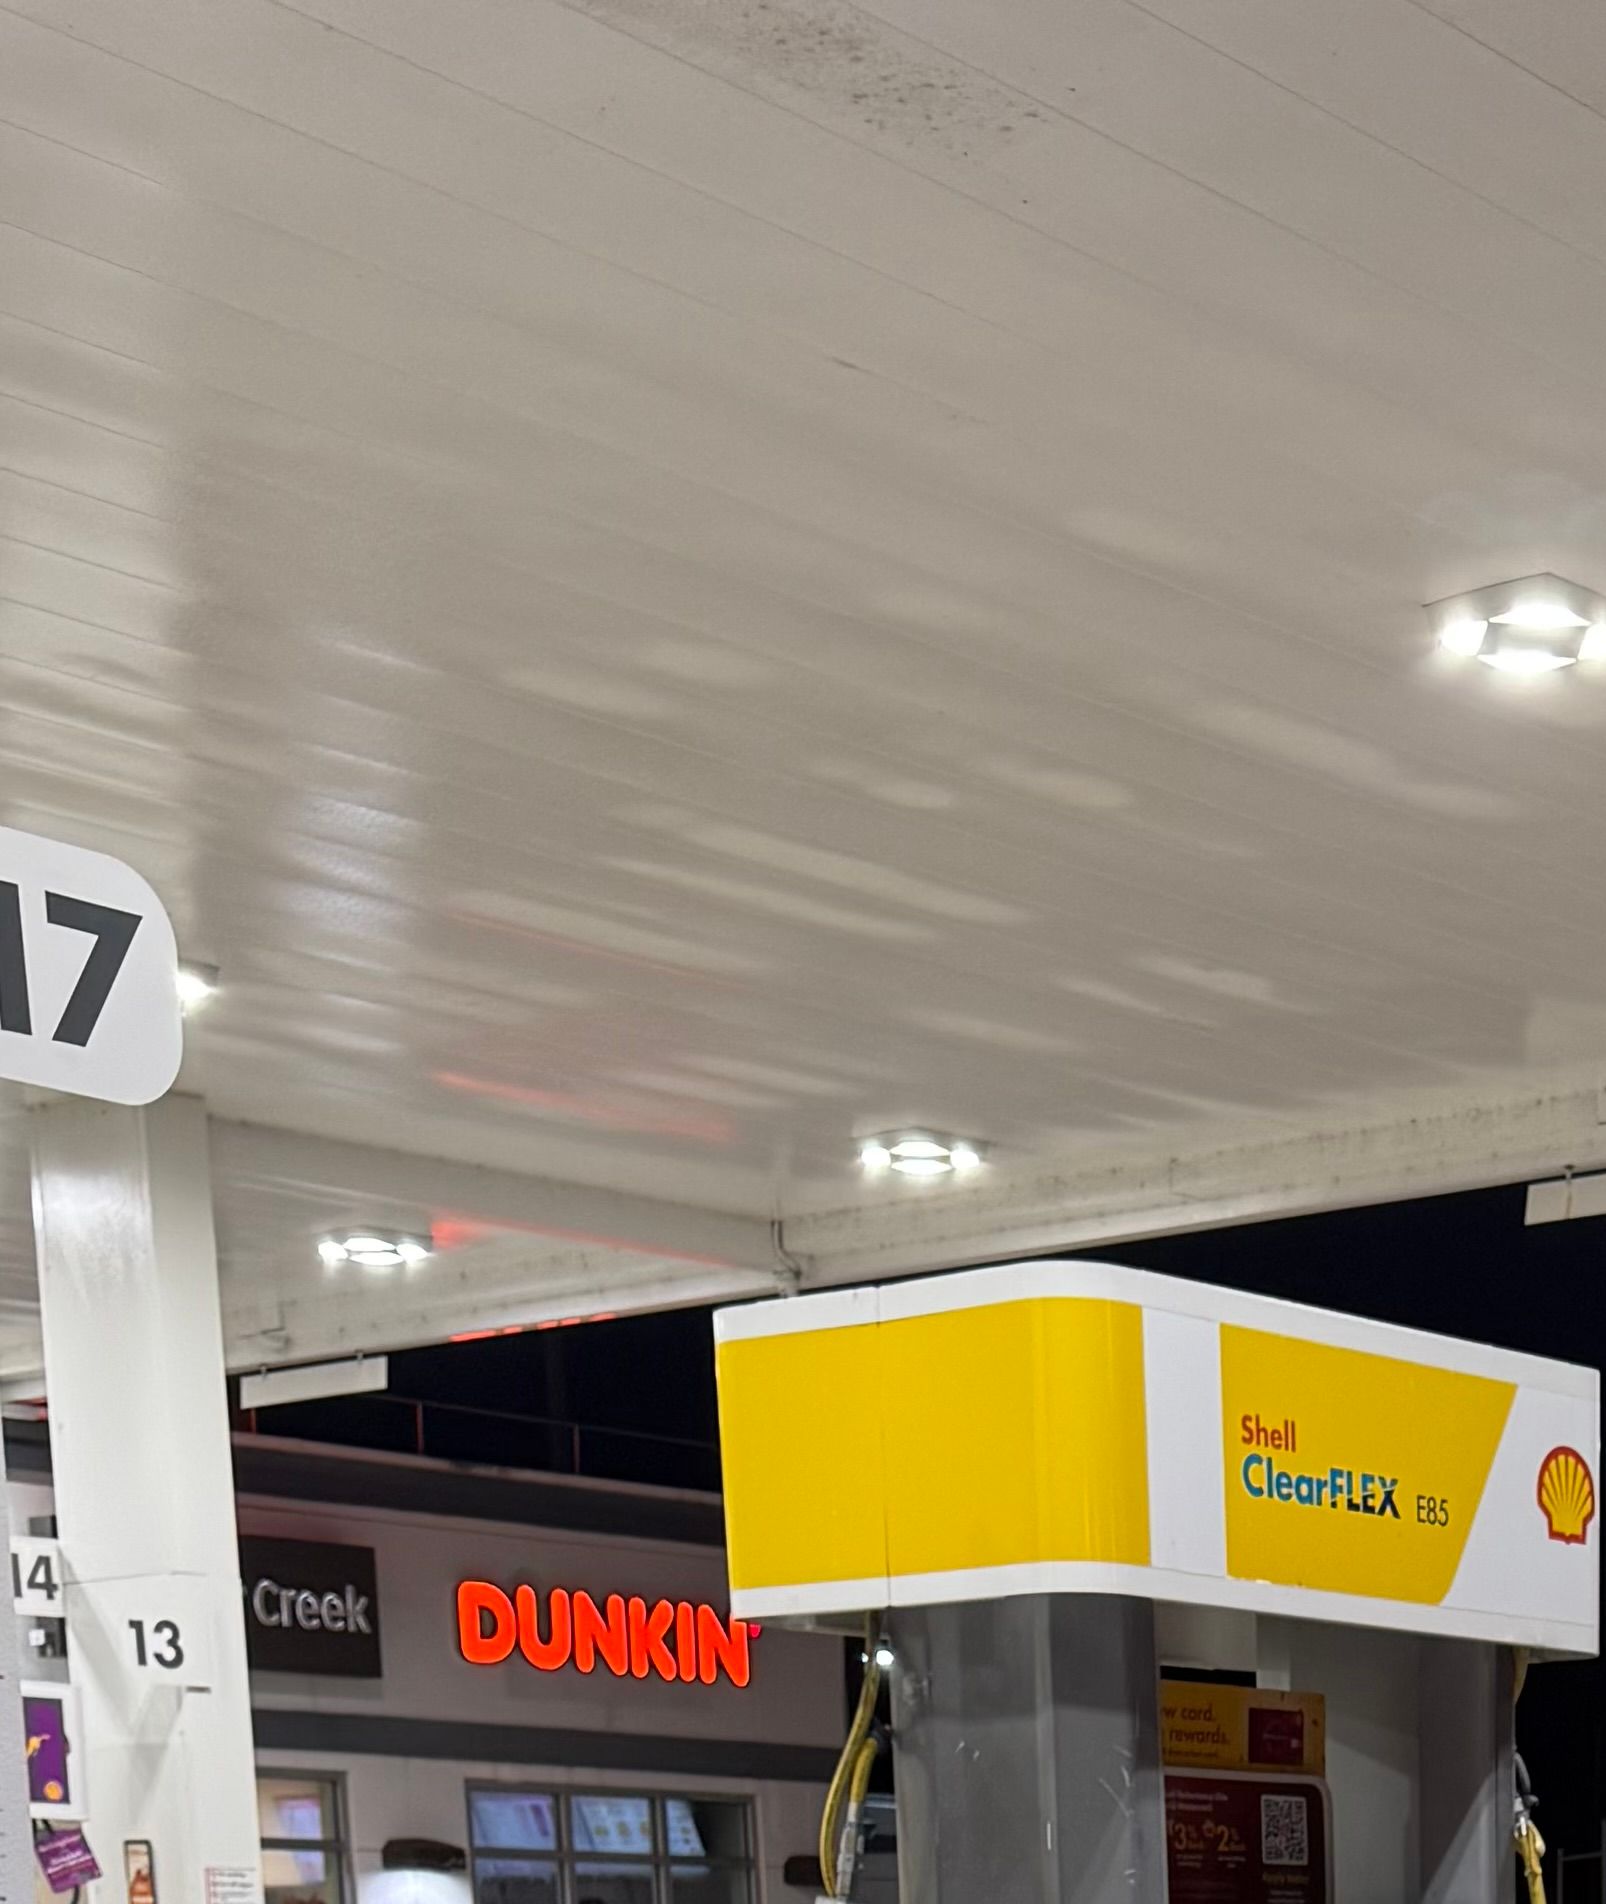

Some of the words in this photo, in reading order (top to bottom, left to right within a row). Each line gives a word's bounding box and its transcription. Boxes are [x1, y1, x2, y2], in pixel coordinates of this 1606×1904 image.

[1241, 1414, 1297, 1453] Shell
[1241, 1452, 1402, 1520] ClearFLEX
[1416, 1494, 1450, 1527] E85
[10, 1552, 59, 1601] 14
[252, 1577, 372, 1635] Creek
[128, 1619, 185, 1670] 13
